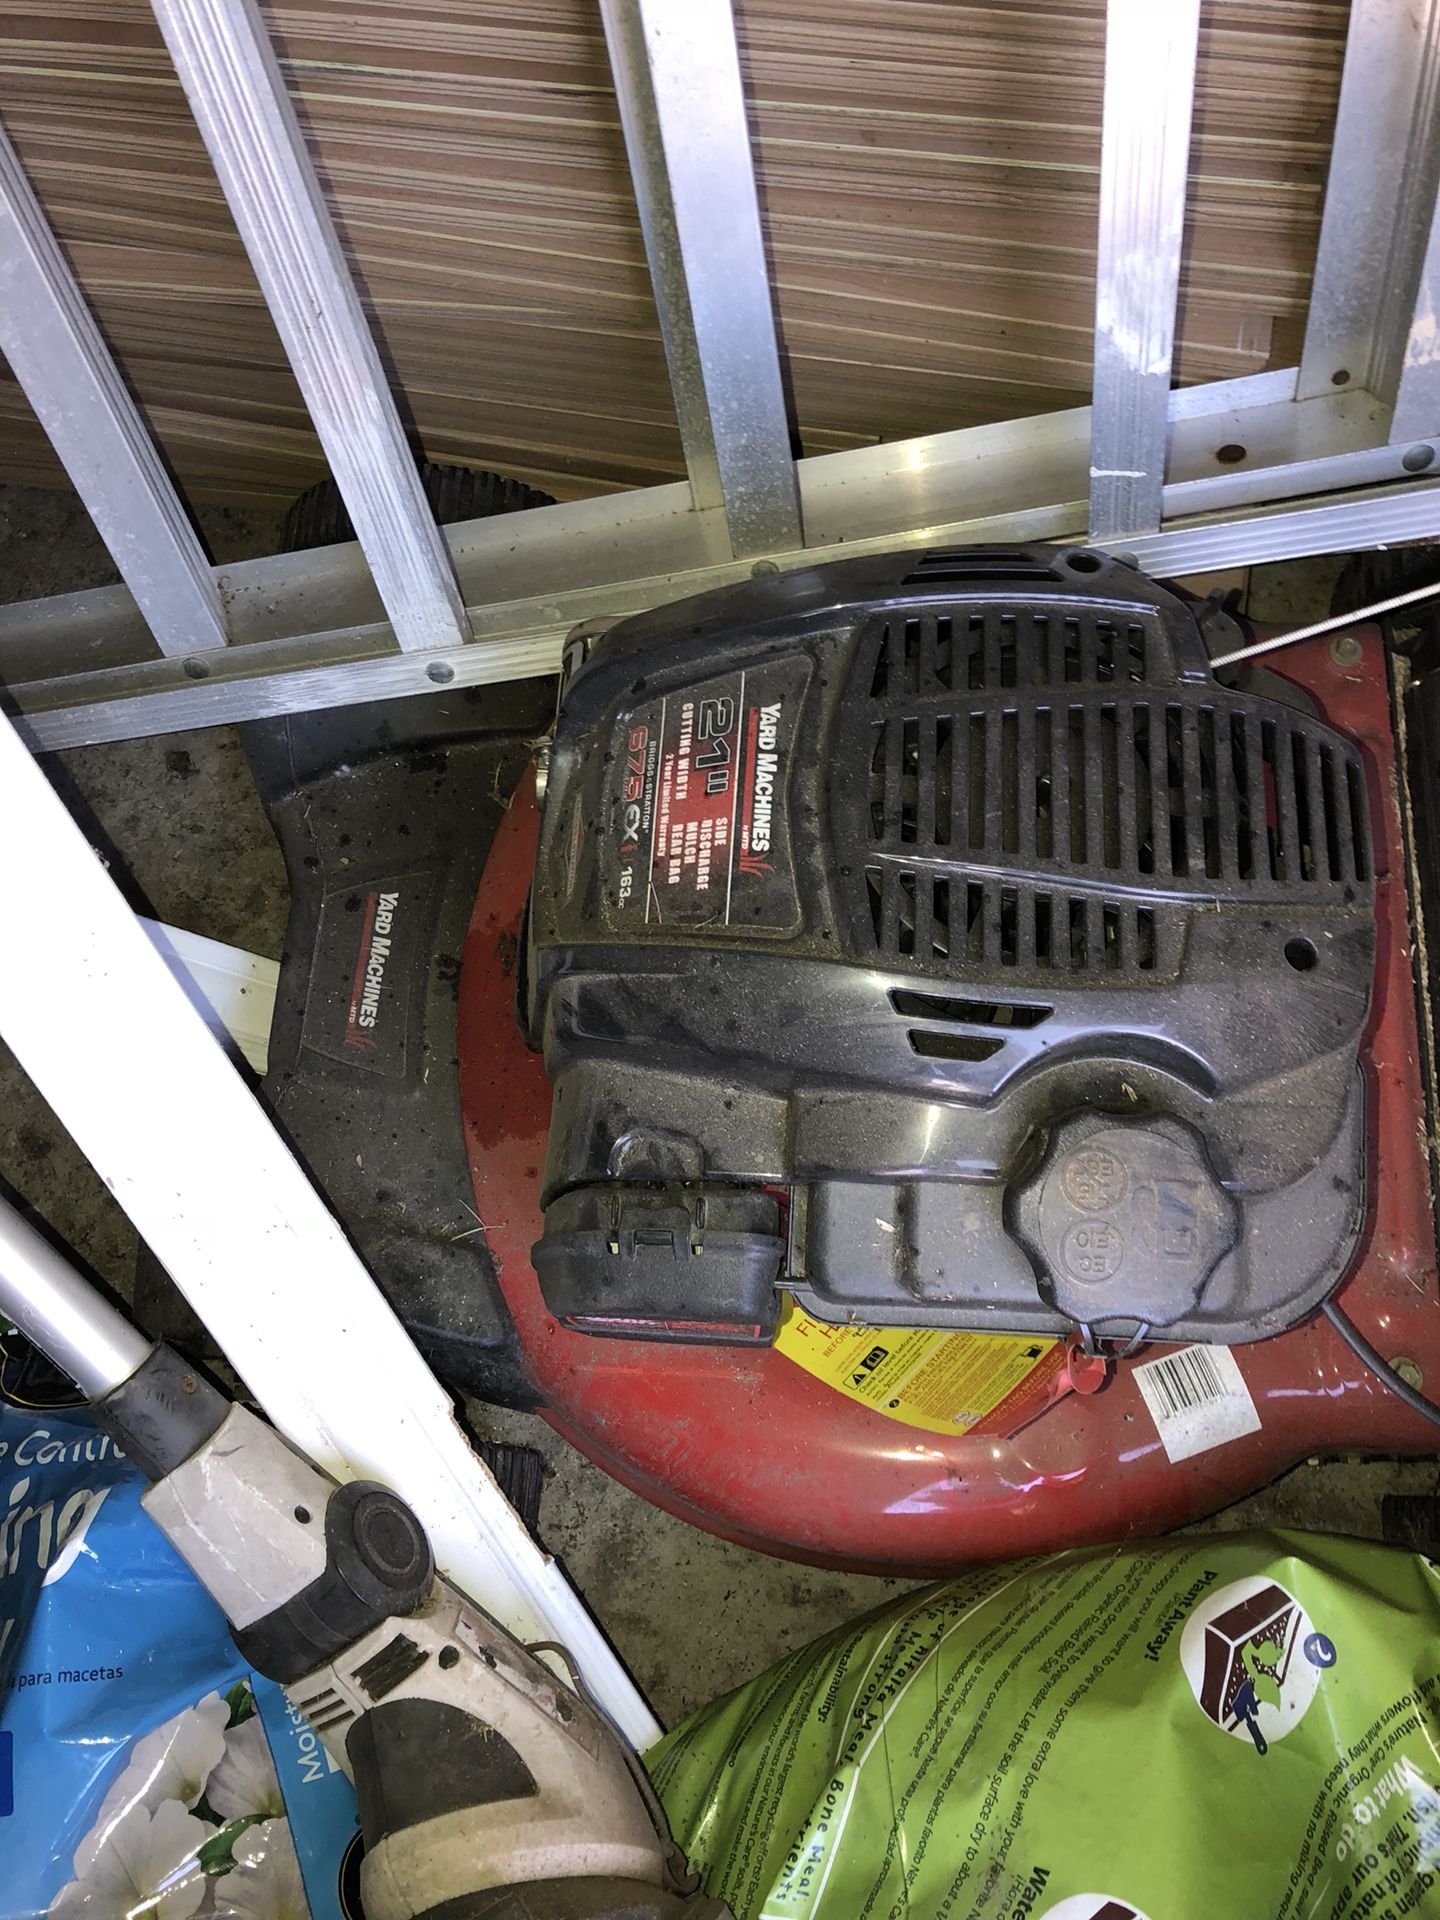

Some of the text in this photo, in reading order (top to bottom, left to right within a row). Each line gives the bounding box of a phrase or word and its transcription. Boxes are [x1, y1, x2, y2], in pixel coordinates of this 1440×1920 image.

[674, 701, 694, 800] CUTTING WIDTH
[663, 760, 674, 781] Year
[749, 701, 780, 853] YARD MACHINES
[661, 781, 672, 811] Limited
[656, 812, 670, 856] Warranty
[683, 821, 698, 864] MULCH
[713, 815, 728, 846] SIDE
[740, 831, 749, 849] MTD
[667, 823, 683, 884] REAR BAG
[695, 819, 712, 890] DISCHARGE
[357, 890, 398, 1028] YARD MACHINES
[347, 1006, 356, 1023] MTD
[1093, 1580, 1126, 1618] Organic
[1126, 1577, 1142, 1596] you
[1178, 1565, 1216, 1611] Plant
[1112, 1594, 1131, 1615] also
[1137, 1595, 1154, 1616] you
[1070, 1612, 1099, 1643] Raised
[1094, 1611, 1118, 1637] don't
[1142, 1607, 1185, 1664] Away!
[978, 1649, 995, 1666] que
[1054, 1638, 1075, 1659] Bed
[1066, 1652, 1080, 1667] to
[1075, 1633, 1097, 1657] want
[1101, 1654, 1114, 1667] to
[1309, 1639, 1335, 1662] 2
[18, 1672, 51, 1686] para
[57, 1666, 123, 1682] macetas
[875, 1642, 929, 1706] Alfalfa
[973, 1664, 984, 1676] la
[992, 1668, 1011, 1692] amor
[1037, 1654, 1059, 1677] Soil.
[1083, 1663, 1105, 1686] give
[853, 1652, 893, 1721] strong
[942, 1682, 956, 1697] de
[948, 1672, 979, 1716] superficie
[983, 1691, 997, 1710] con
[1028, 1661, 1070, 1713] overwater.
[1064, 1682, 1089, 1709] them
[797, 1713, 809, 1729] the
[924, 1695, 949, 1732] Nature's
[943, 1715, 955, 1727] se
[977, 1709, 988, 1722] su
[1017, 1711, 1036, 1733] Let
[1045, 1706, 1069, 1740] some
[1378, 1687, 1423, 1729] flowers
[274, 1682, 322, 1784] Moist
[765, 1722, 780, 1745] your
[783, 1716, 797, 1735] and
[928, 1726, 948, 1755] seque
[1362, 1719, 1385, 1744] what
[1380, 1709, 1427, 1753] Nature's
[770, 1733, 790, 1767] forests
[784, 1728, 803, 1763] world's
[952, 1721, 983, 1769] fertilizante
[1006, 1731, 1025, 1753] the
[1029, 1740, 1053, 1772] extra
[1345, 1737, 1371, 1763] they
[745, 1744, 773, 1806] environment
[773, 1762, 792, 1795] largest
[914, 1754, 935, 1781] hasta
[939, 1767, 957, 1791] para
[996, 1752, 1014, 1775] soil
[1321, 1756, 1351, 1792] need
[761, 1776, 773, 1794] our
[904, 1779, 919, 1798] una
[977, 1774, 1005, 1822] surface
[1016, 1772, 1038, 1800] love
[1330, 1765, 1372, 1810] Organic
[739, 1805, 752, 1825] and
[747, 1795, 769, 1837] Nature's
[759, 1796, 782, 1841] recycling
[815, 1778, 845, 1834] Bone
[924, 1789, 946, 1825] plantas
[1008, 1801, 1027, 1829] with
[1310, 1790, 1329, 1820] with
[1329, 1753, 1419, 1863] What to do
[730, 1824, 746, 1852] make
[884, 1797, 911, 1858] profundidad
[967, 1820, 989, 1846] dry
[1304, 1820, 1317, 1839] no
[1314, 1809, 1340, 1856] Raised
[1376, 1821, 1409, 1859] That's
[912, 1826, 933, 1865] favorito
[963, 1846, 979, 1862] to
[995, 1828, 1016, 1860] your
[725, 1852, 738, 1870] the
[750, 1841, 769, 1881] efforts?
[791, 1843, 825, 1906] Meal,
[1287, 1839, 1313, 1886] mixing
[1304, 1856, 1324, 1887] Bed
[1347, 1851, 1380, 1888] our
[743, 1880, 759, 1907] Each
[861, 1855, 893, 1914] aproximada
[896, 1864, 920, 1906] Nature's
[946, 1861, 973, 1901] about
[973, 1860, 1005, 1909] favorite
[1380, 1867, 1406, 1894] of
[1394, 1870, 1434, 1916] garden
[941, 1899, 953, 1910] a
[1275, 1887, 1294, 1919] requ
